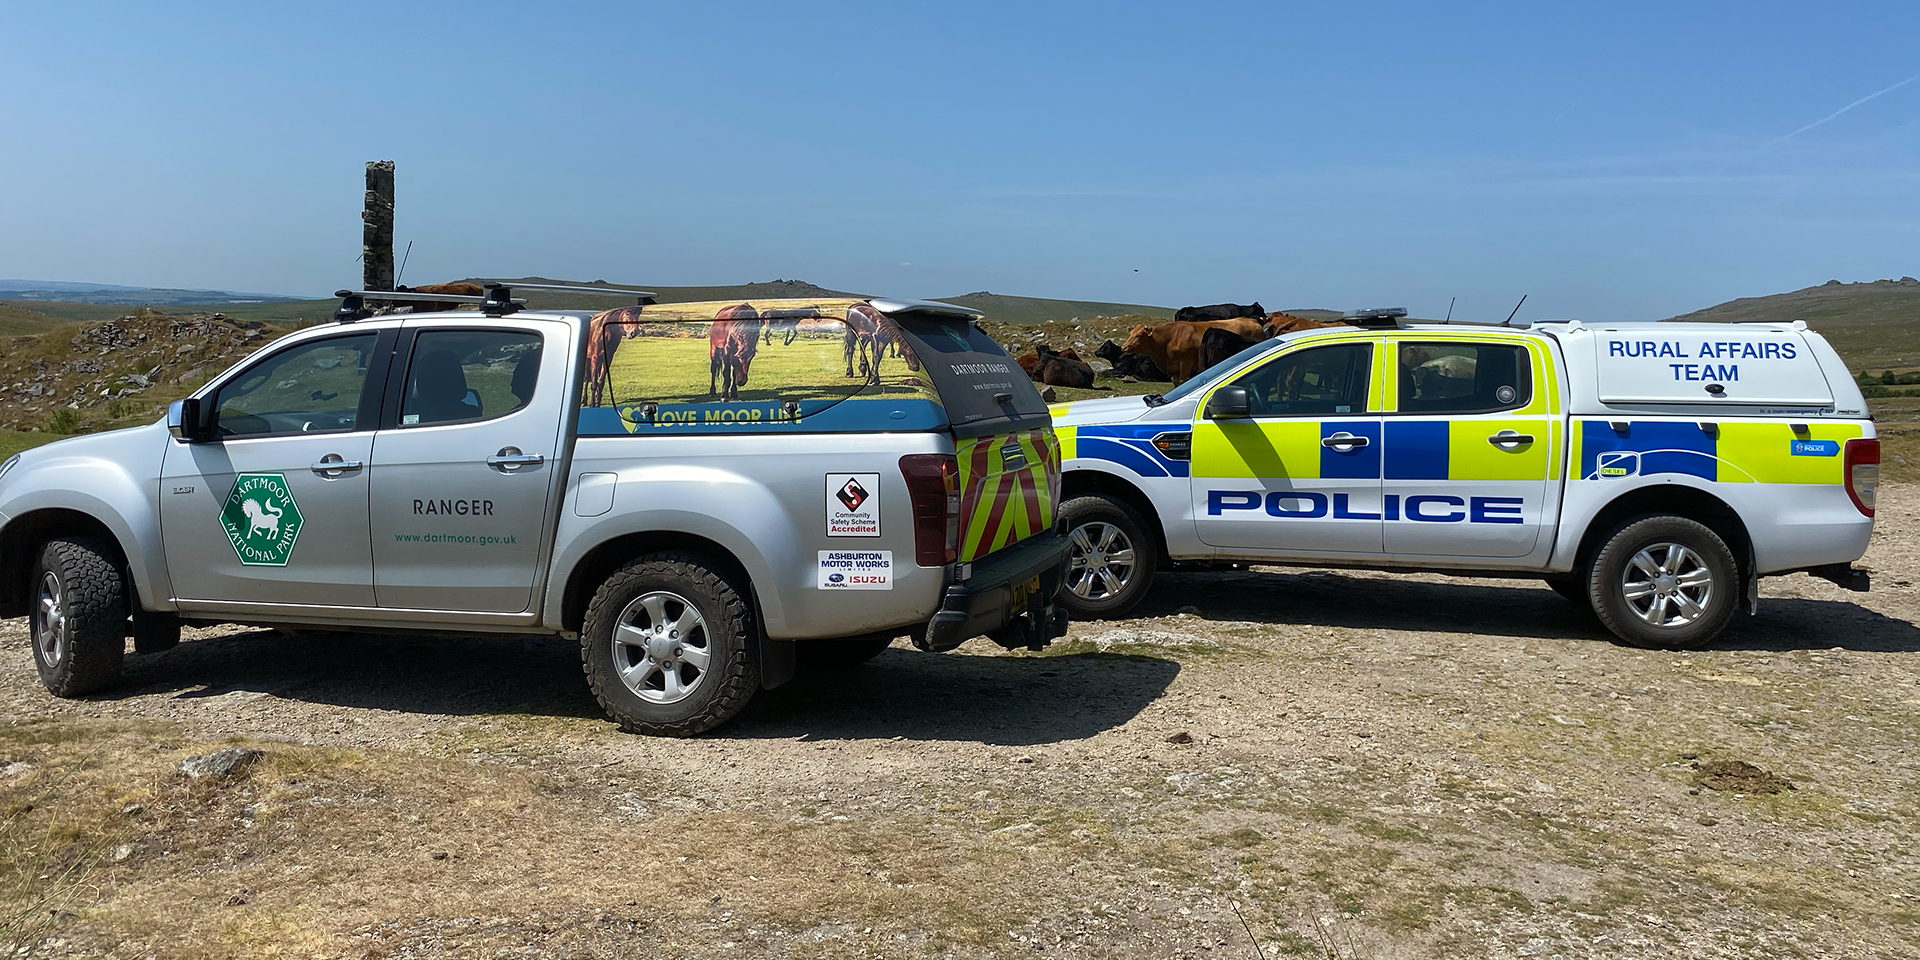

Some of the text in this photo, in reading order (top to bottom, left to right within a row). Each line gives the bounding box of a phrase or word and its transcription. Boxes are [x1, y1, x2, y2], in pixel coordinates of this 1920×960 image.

[1609, 341, 1797, 360] RURAL AFFAIRS
[950, 363, 1011, 375] DARTMOOR RANGER
[1669, 364, 1739, 381] TEAM
[653, 410, 697, 428] LOVE
[704, 409, 762, 426] MOOR
[231, 477, 290, 507] DARTMOOR
[413, 499, 494, 516] RANGER
[1207, 490, 1524, 524] POLICE
[228, 522, 295, 561] NATIONAL PARK
[395, 533, 517, 546] www.dartmoor.gov.uk
[821, 560, 890, 568] MOTOR WORKS
[828, 552, 882, 560] ASHBURTON
